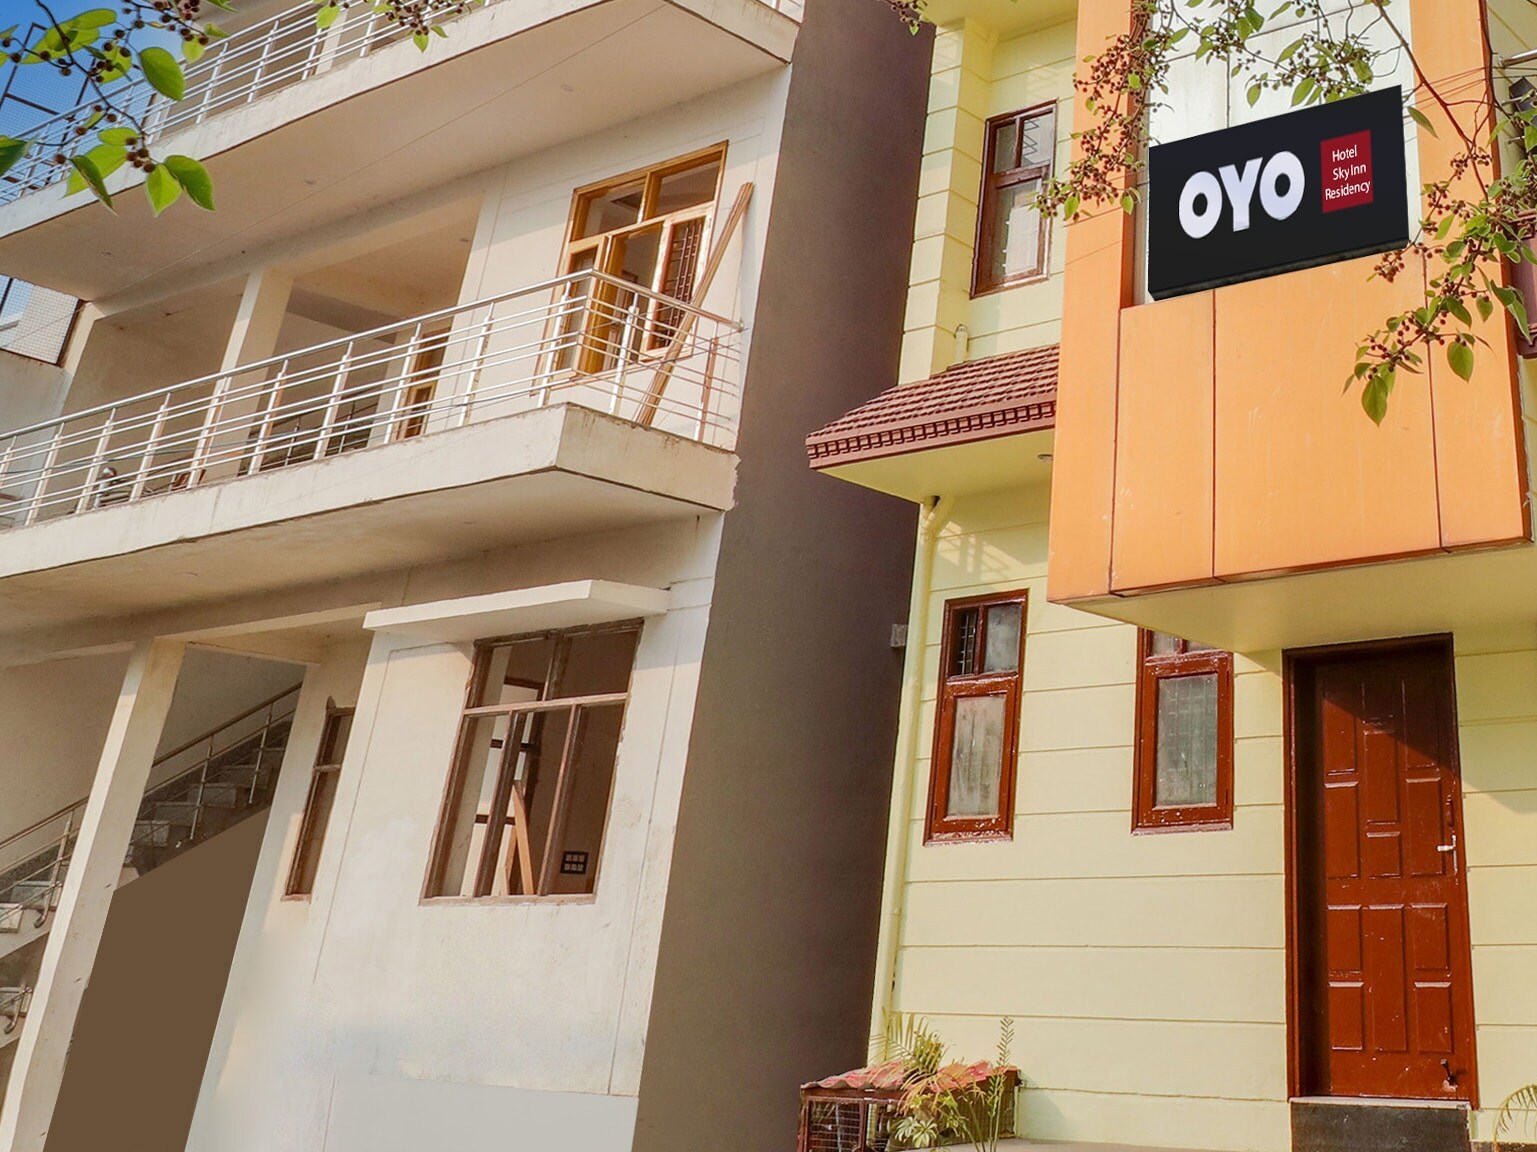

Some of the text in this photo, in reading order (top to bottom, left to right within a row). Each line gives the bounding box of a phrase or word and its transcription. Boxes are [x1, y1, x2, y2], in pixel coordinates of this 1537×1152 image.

[1332, 144, 1357, 162] Hotel
[1333, 163, 1366, 181] Sky Inn
[1179, 151, 1305, 238] OYO
[1325, 180, 1371, 200] Residency
